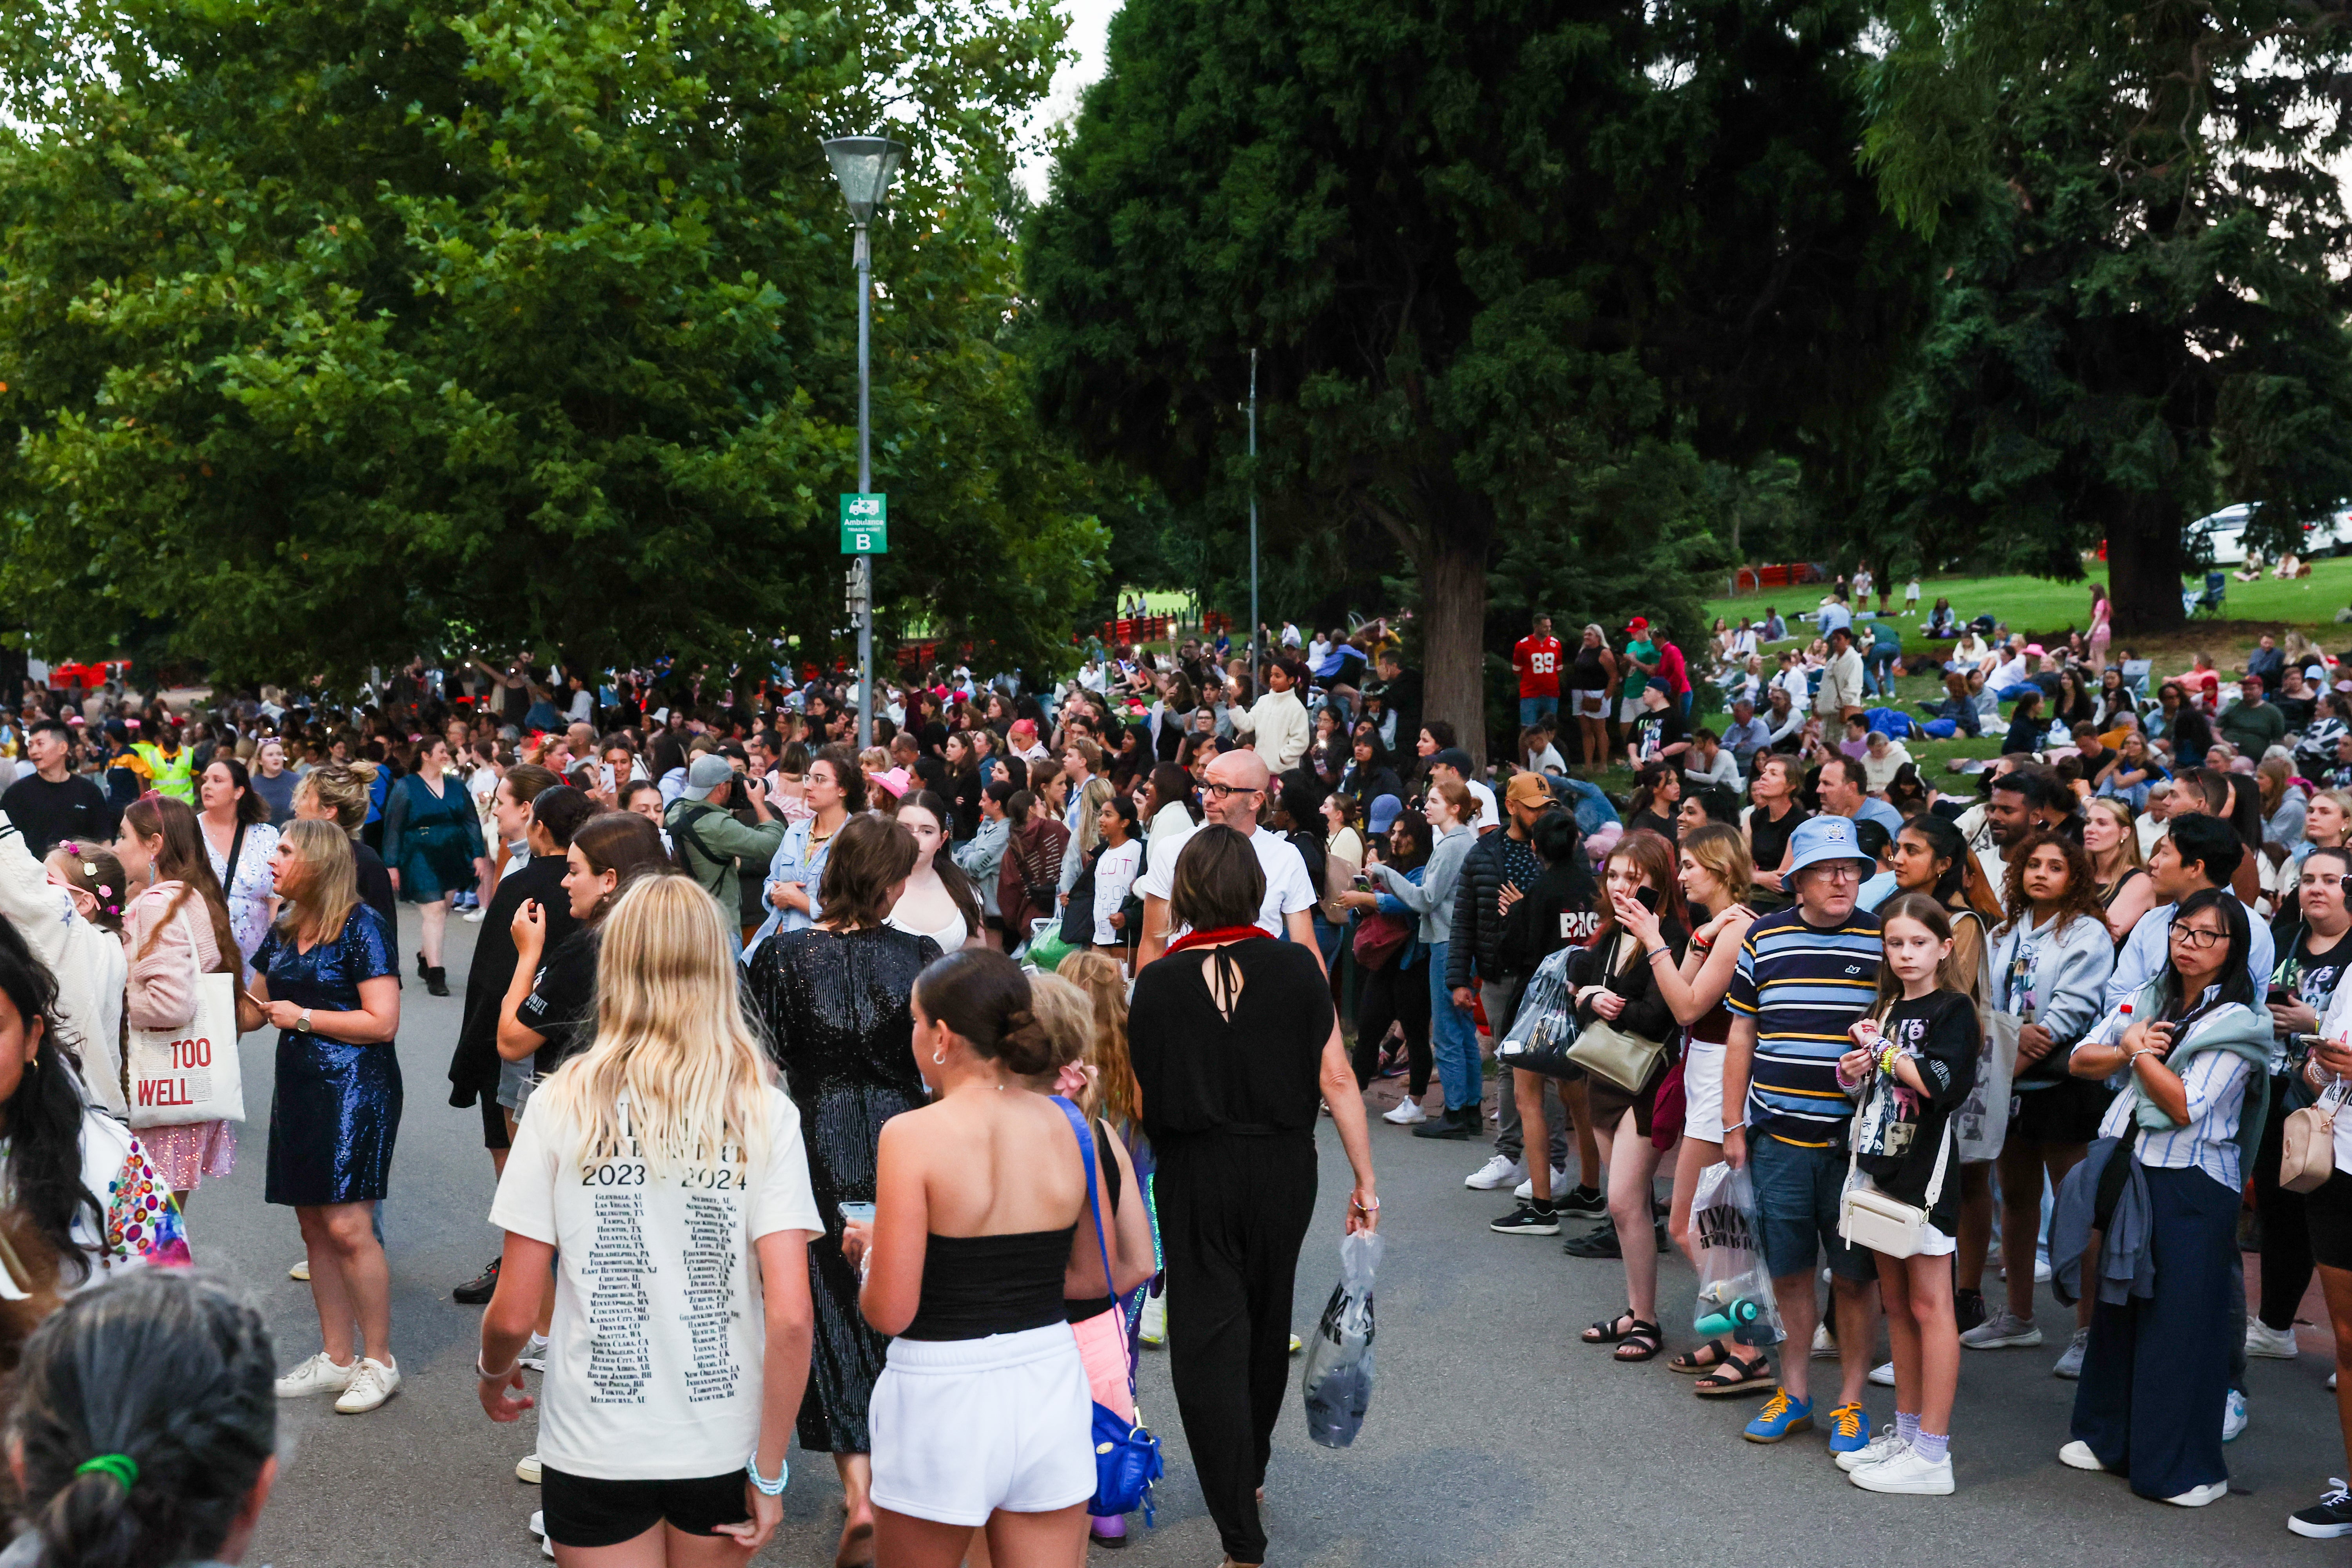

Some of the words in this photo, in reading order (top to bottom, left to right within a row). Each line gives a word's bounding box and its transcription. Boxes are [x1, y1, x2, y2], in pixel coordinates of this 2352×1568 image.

[856, 534, 871, 550] B
[1531, 652, 1555, 673] 89
[1535, 777, 1546, 790] LA
[1102, 858, 1132, 875] LOT
[171, 1038, 211, 1069] TOO
[138, 1078, 193, 1106] WELL
[583, 1165, 645, 1186] 2023
